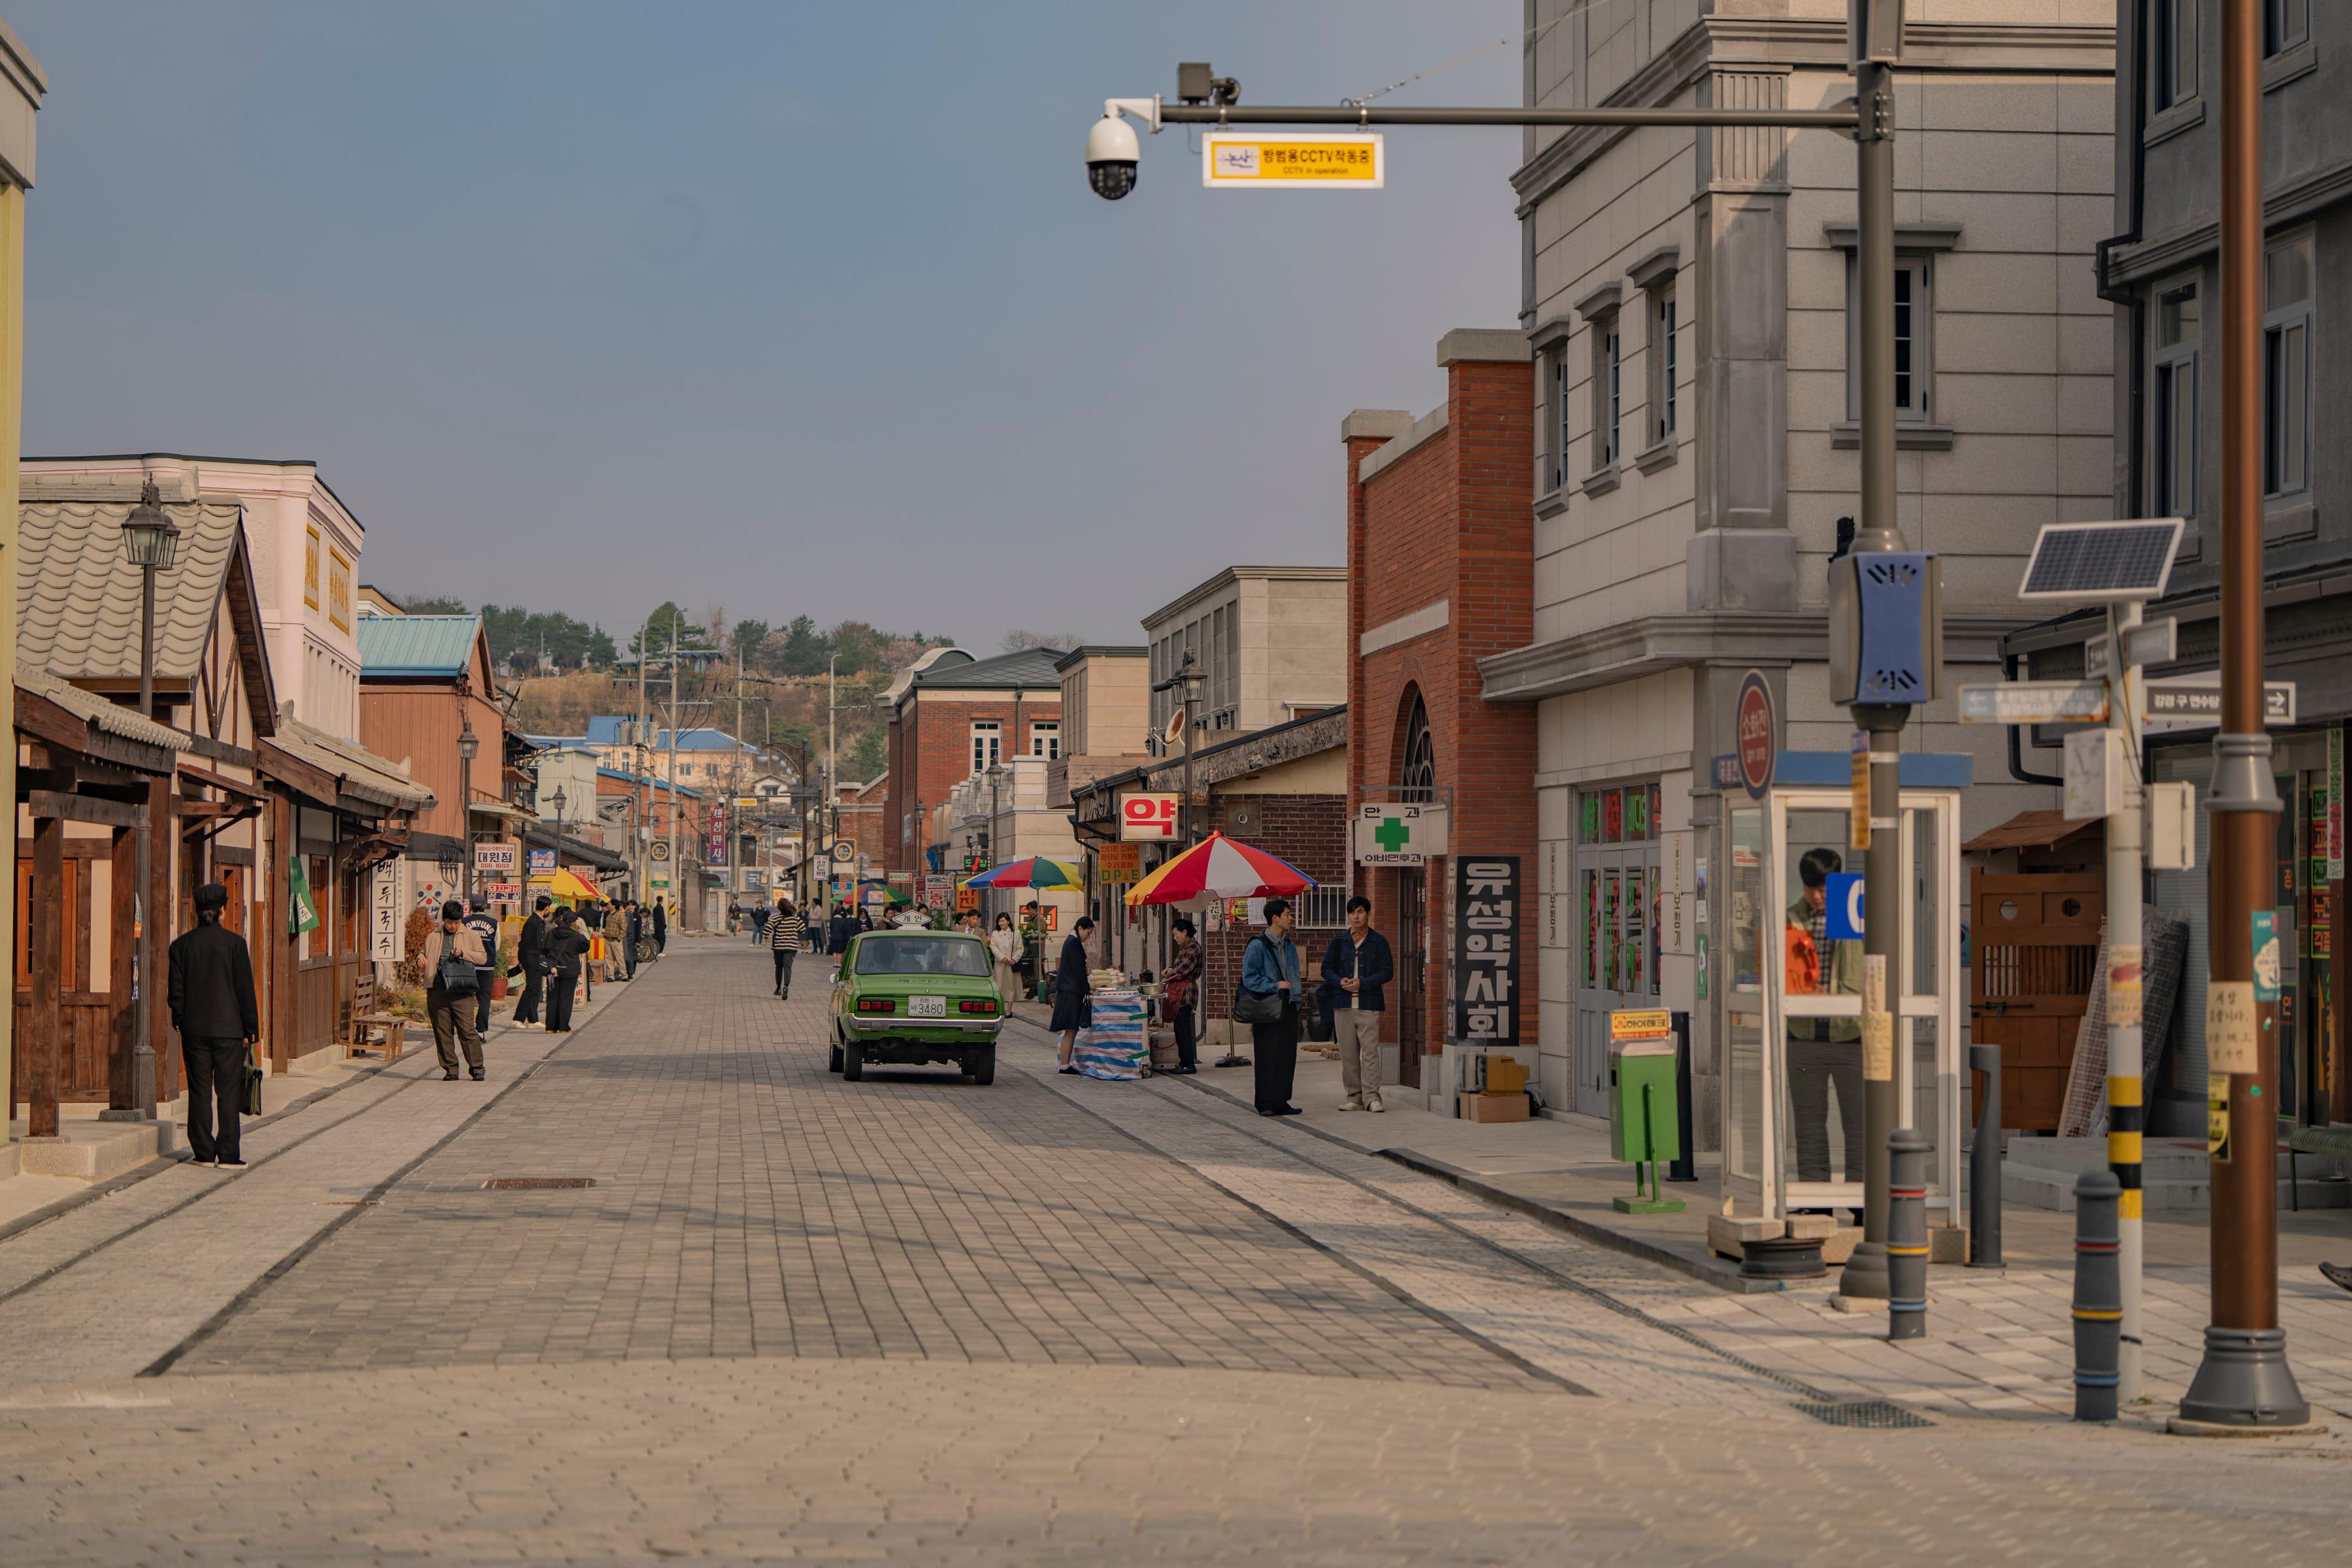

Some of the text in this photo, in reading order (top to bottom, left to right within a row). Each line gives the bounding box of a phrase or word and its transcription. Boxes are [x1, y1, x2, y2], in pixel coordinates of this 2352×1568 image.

[1264, 148, 1369, 163] 방범용CCTV작동중
[1315, 166, 1348, 174] operation
[2176, 694, 2188, 710] 구
[1124, 798, 1176, 836] 약
[1364, 807, 1420, 819] 안 과
[711, 808, 723, 858] 세상만사
[478, 852, 512, 862] 대원점
[1365, 853, 1421, 862] 이비인후과
[378, 860, 393, 955] 백두국수
[1465, 862, 1512, 1039] 유성약사회
[918, 1004, 943, 1014] 3480
